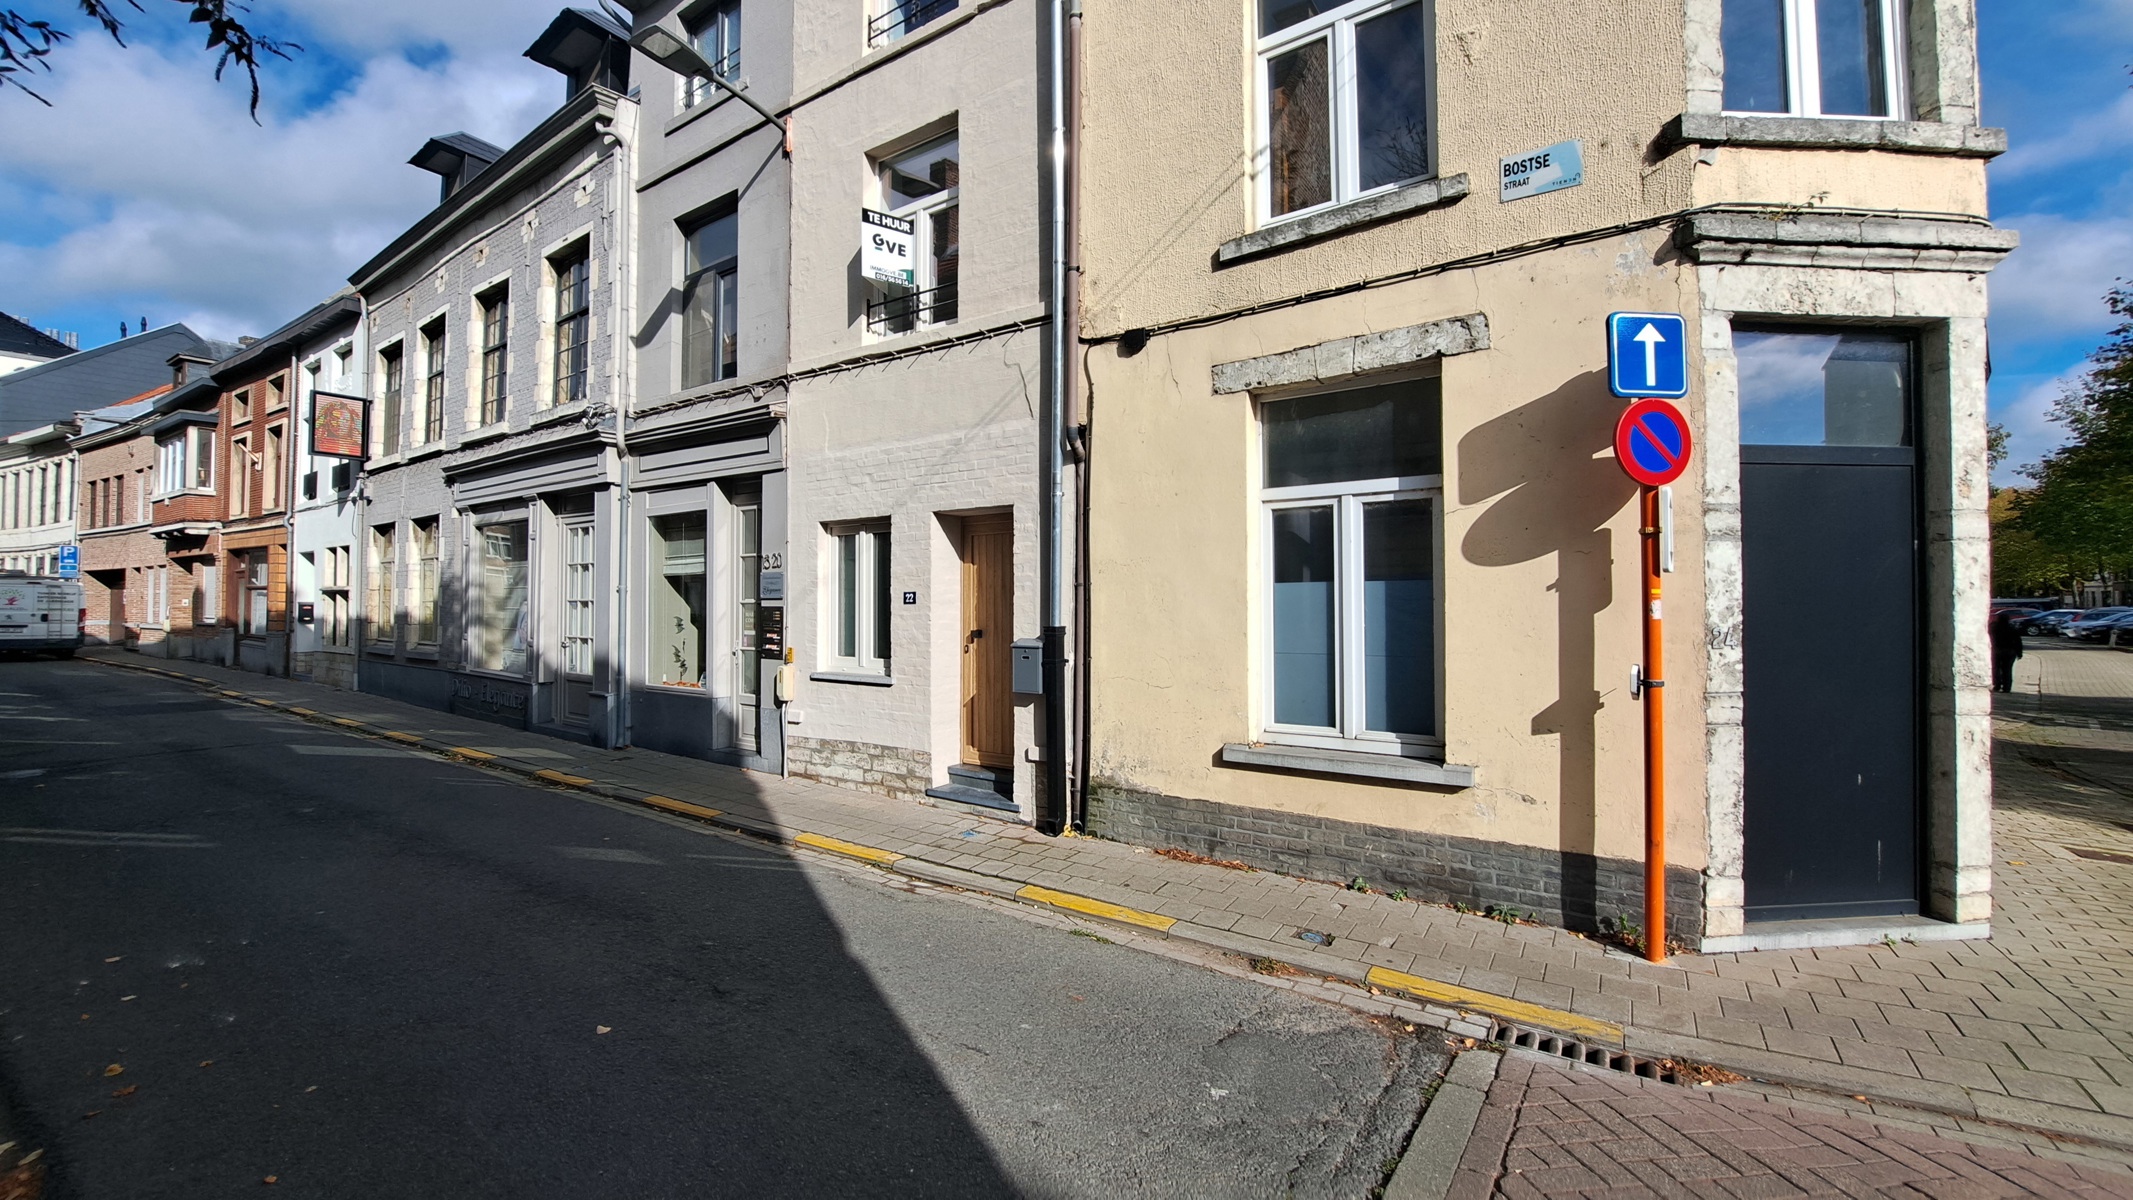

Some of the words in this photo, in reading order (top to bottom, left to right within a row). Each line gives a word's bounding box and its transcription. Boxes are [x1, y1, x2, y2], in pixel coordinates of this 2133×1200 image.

[1503, 153, 1551, 178] BOSTSE
[1503, 176, 1530, 191] STRAAT
[867, 211, 881, 224] TE
[882, 215, 911, 233] HUUR
[872, 233, 907, 257] GVE
[63, 546, 75, 557] P
[905, 593, 914, 603] 22
[1711, 626, 1738, 650] 24
[480, 682, 524, 712] Elegance
